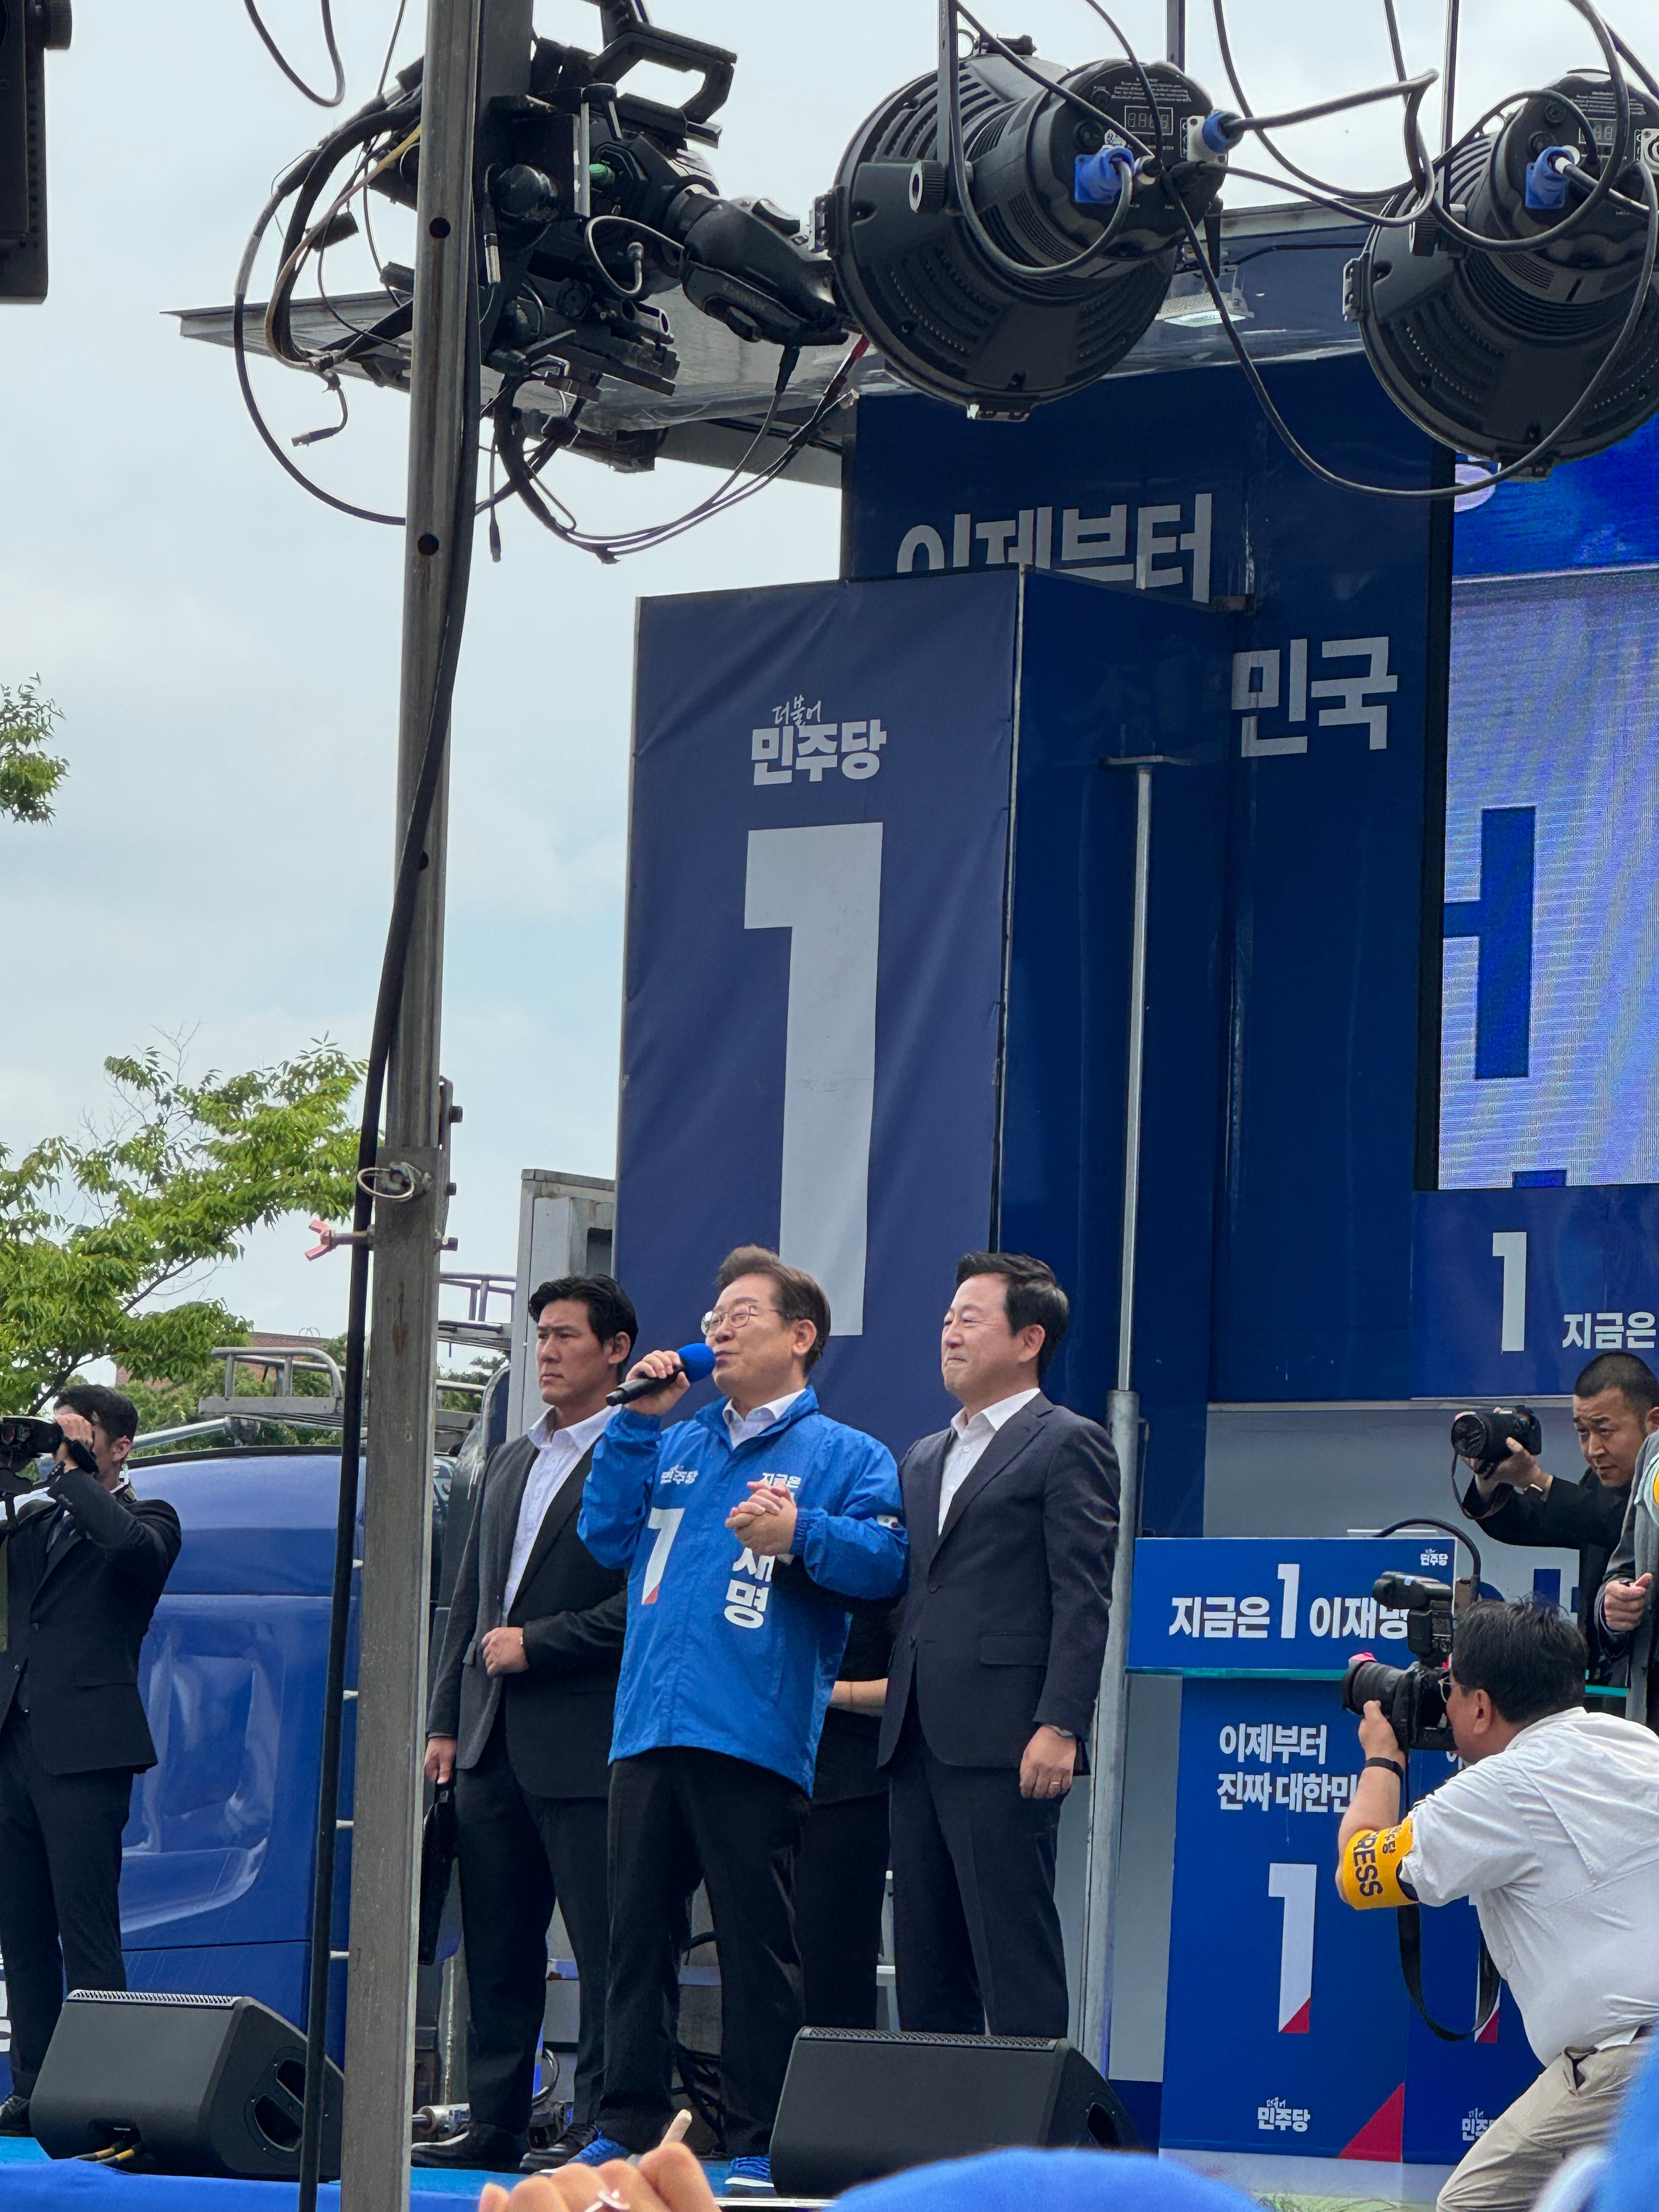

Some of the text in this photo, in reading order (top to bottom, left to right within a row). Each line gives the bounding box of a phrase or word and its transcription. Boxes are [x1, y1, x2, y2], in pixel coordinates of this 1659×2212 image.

[751, 719, 887, 785] 민주당
[744, 822, 883, 1336] 1
[1492, 1232, 1527, 1352] 1
[1562, 1312, 1656, 1349] 지금은
[641, 1508, 685, 1605] 1
[1169, 1596, 1270, 1638] 지금은
[1277, 1564, 1300, 1639] 1
[1219, 1723, 1327, 1765] 이제부터
[1217, 1771, 1272, 1812] 진짜
[1268, 1863, 1317, 2034] 1
[1258, 2107, 1311, 2132] 민주당
[1462, 2118, 1498, 2141] 민주
